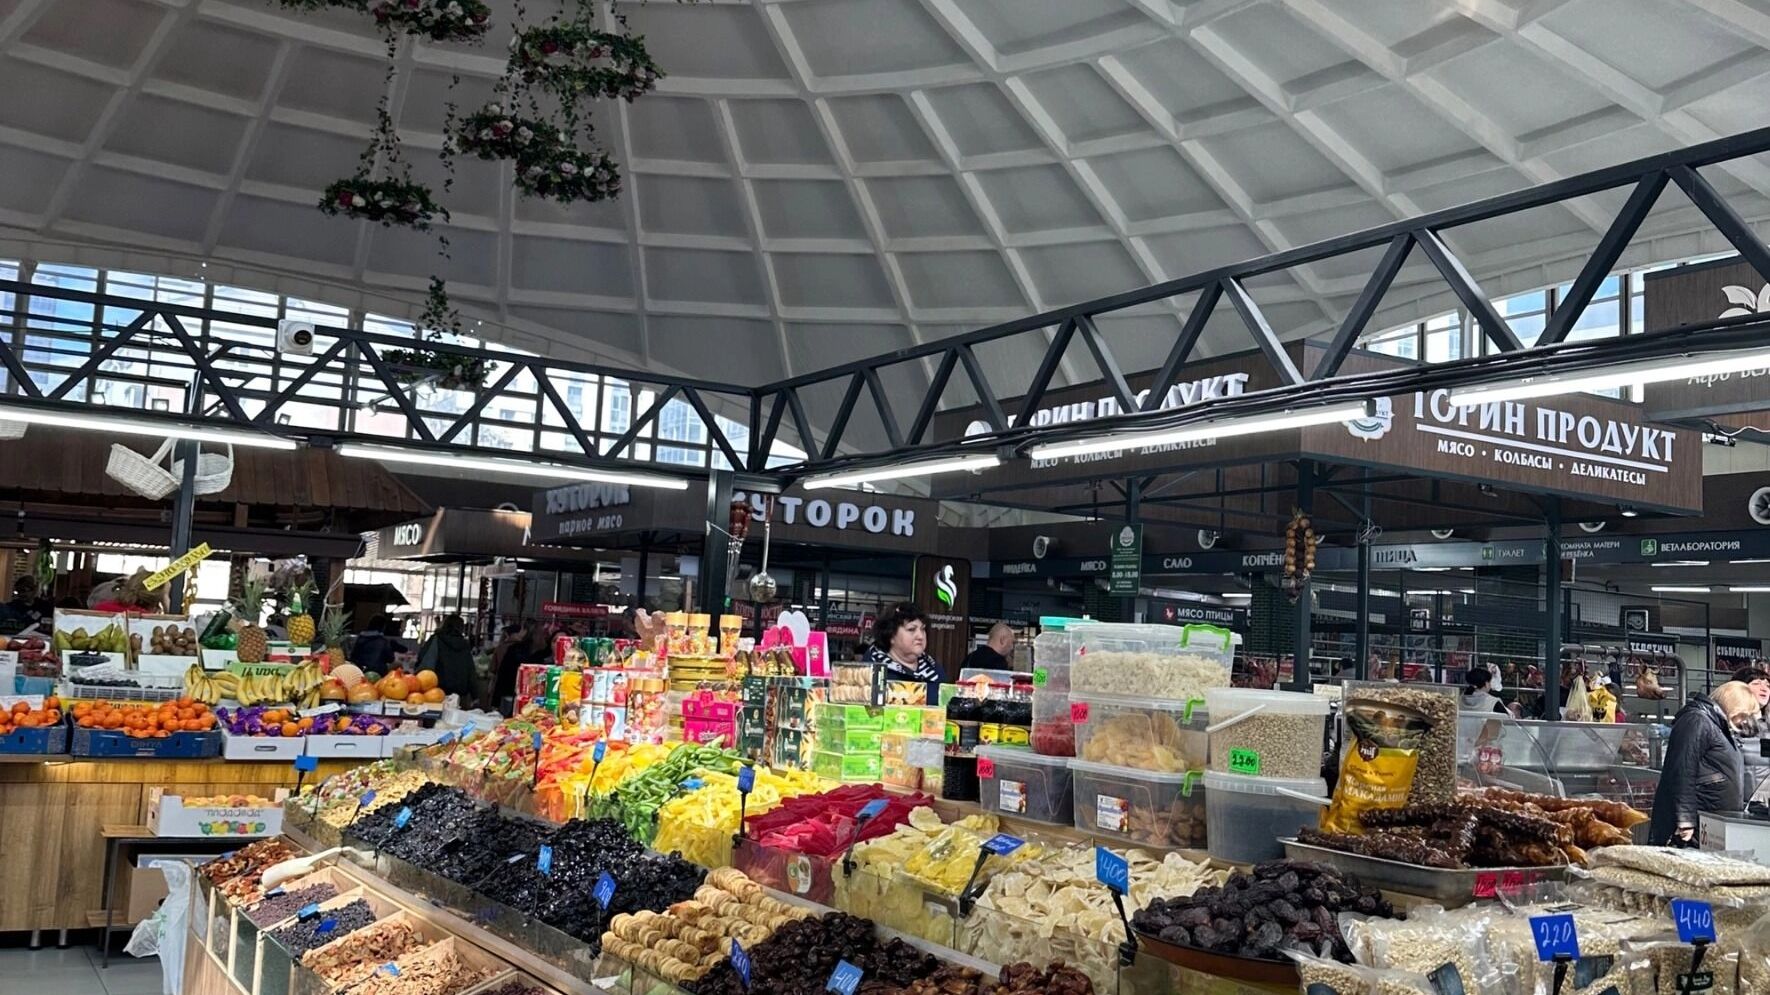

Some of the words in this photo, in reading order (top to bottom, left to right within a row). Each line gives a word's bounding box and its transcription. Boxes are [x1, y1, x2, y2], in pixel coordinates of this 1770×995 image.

[1536, 407, 1677, 463] ПРОДУКТ
[1436, 438, 1476, 459] МЯСО
[1494, 448, 1553, 471] КОЛБАСЫ
[1570, 461, 1647, 487] ДЕЛИКАТЕСЫ
[731, 490, 916, 537] УТОРОК
[393, 523, 422, 546] МЯСО
[558, 517, 593, 538] парное
[597, 514, 624, 531] мясо
[1497, 548, 1526, 559] ТУАЛЕТ
[1660, 540, 1741, 552] ВЕТЛАБОРАТОРИЯ
[1080, 560, 1107, 572] МЯСО
[1162, 557, 1193, 570] САЛО
[1177, 607, 1204, 619] МЯСО
[1205, 610, 1234, 621] ПТИЦЫ
[1099, 853, 1127, 883] 1400
[1679, 902, 1712, 931] 440
[1540, 920, 1572, 947] 220
